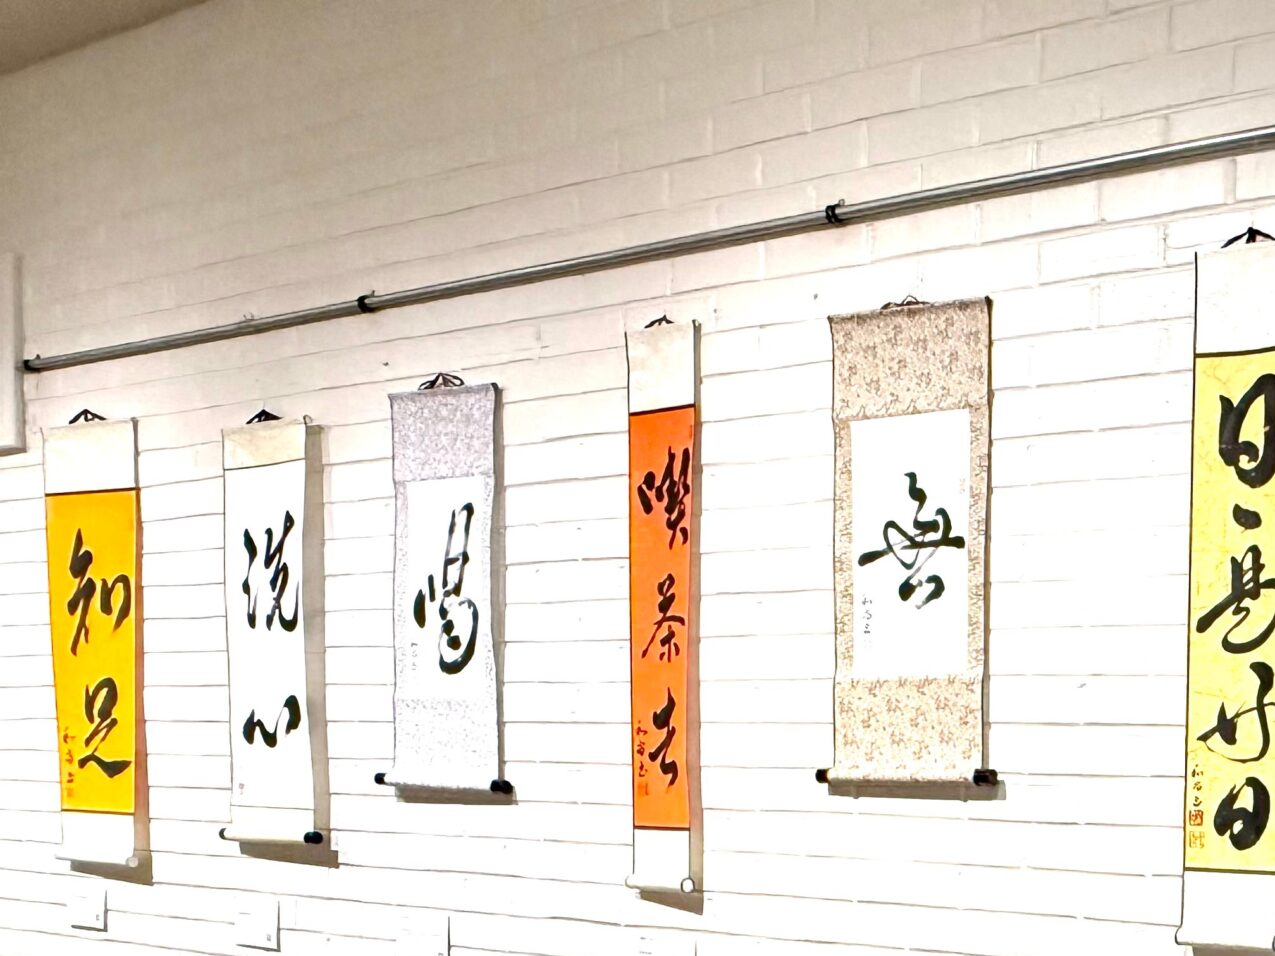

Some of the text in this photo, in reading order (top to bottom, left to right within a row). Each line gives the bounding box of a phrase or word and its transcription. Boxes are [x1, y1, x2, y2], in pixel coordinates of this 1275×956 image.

[242, 510, 301, 749] 洗心
[637, 446, 692, 787] 喫茶去
